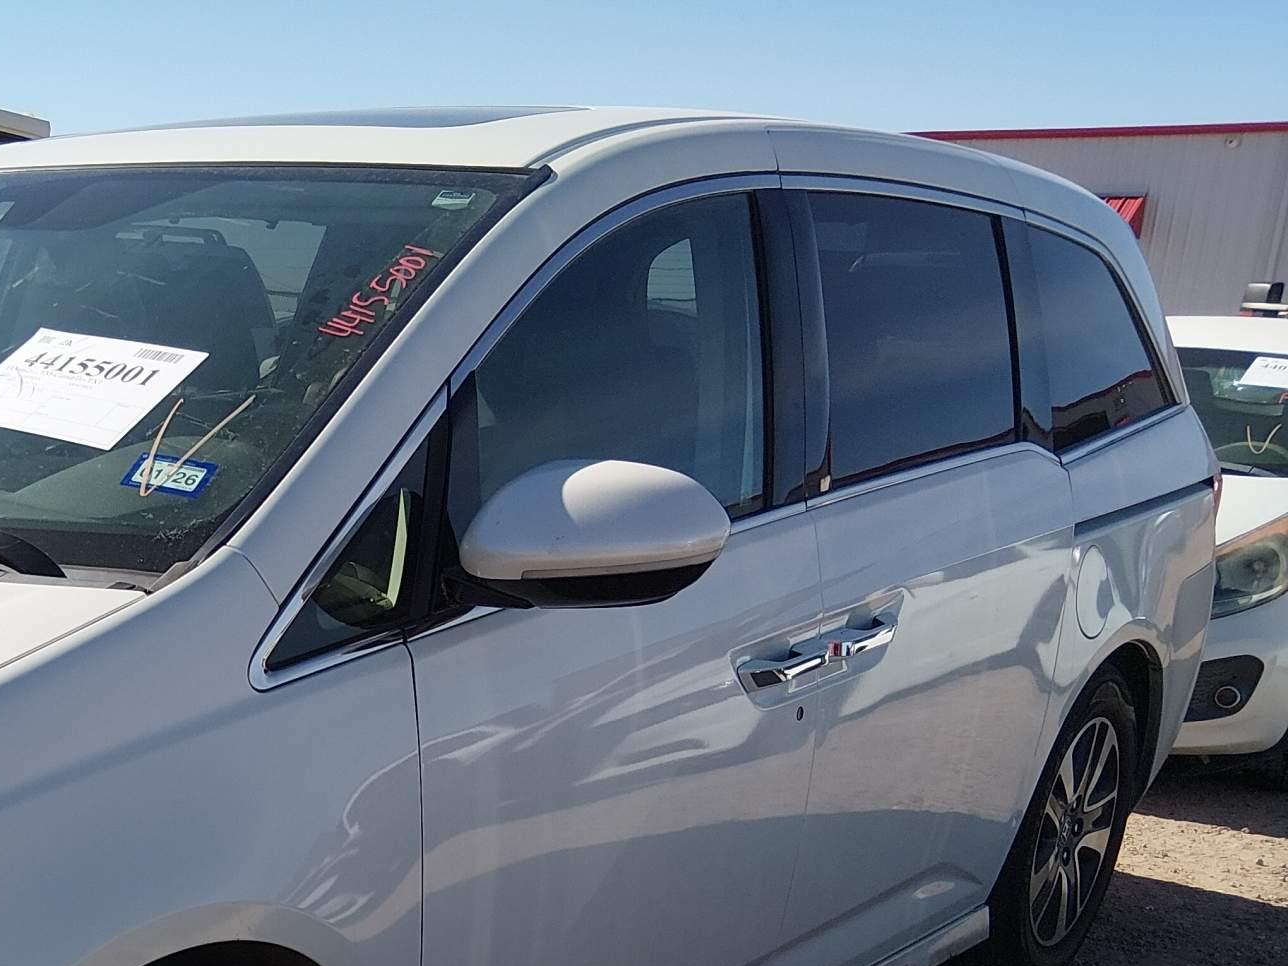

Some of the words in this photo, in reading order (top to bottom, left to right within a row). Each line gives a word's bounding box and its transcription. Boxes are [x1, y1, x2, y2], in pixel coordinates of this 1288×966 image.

[318, 244, 435, 337] 44155001
[24, 351, 161, 386] 44155001
[171, 471, 199, 486] 26
